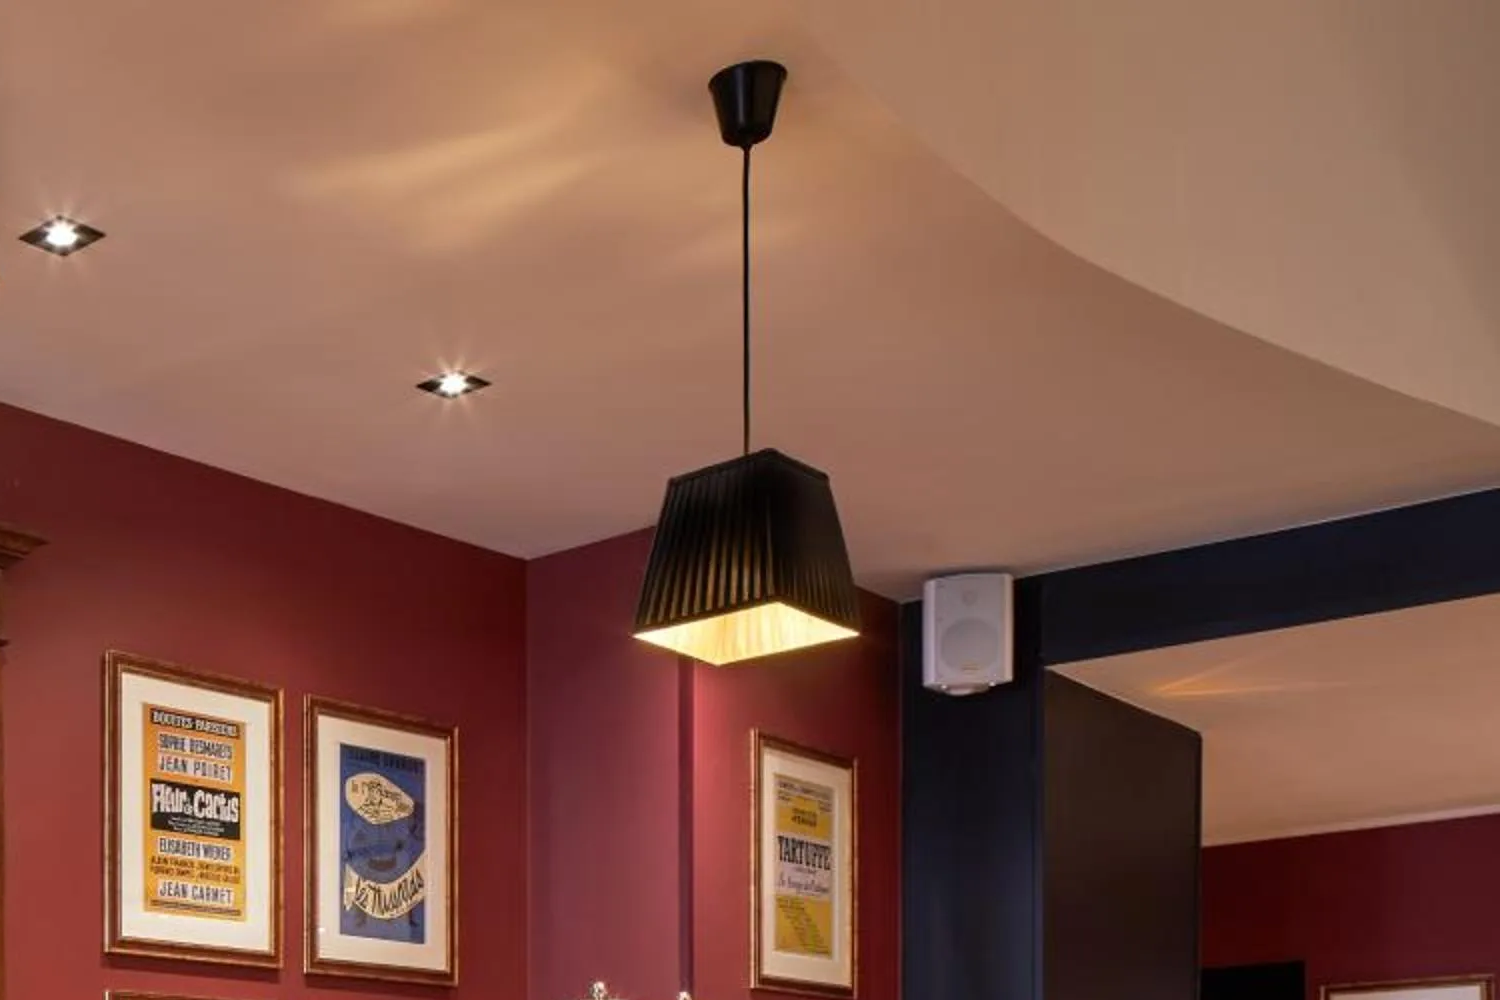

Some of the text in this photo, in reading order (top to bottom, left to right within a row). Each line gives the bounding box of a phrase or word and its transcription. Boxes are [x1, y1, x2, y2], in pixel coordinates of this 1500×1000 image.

[160, 755, 231, 781] JEAN POIRET
[194, 789, 239, 823] Cactus
[777, 835, 832, 871] TARTUFFE
[159, 881, 189, 898] JEAN
